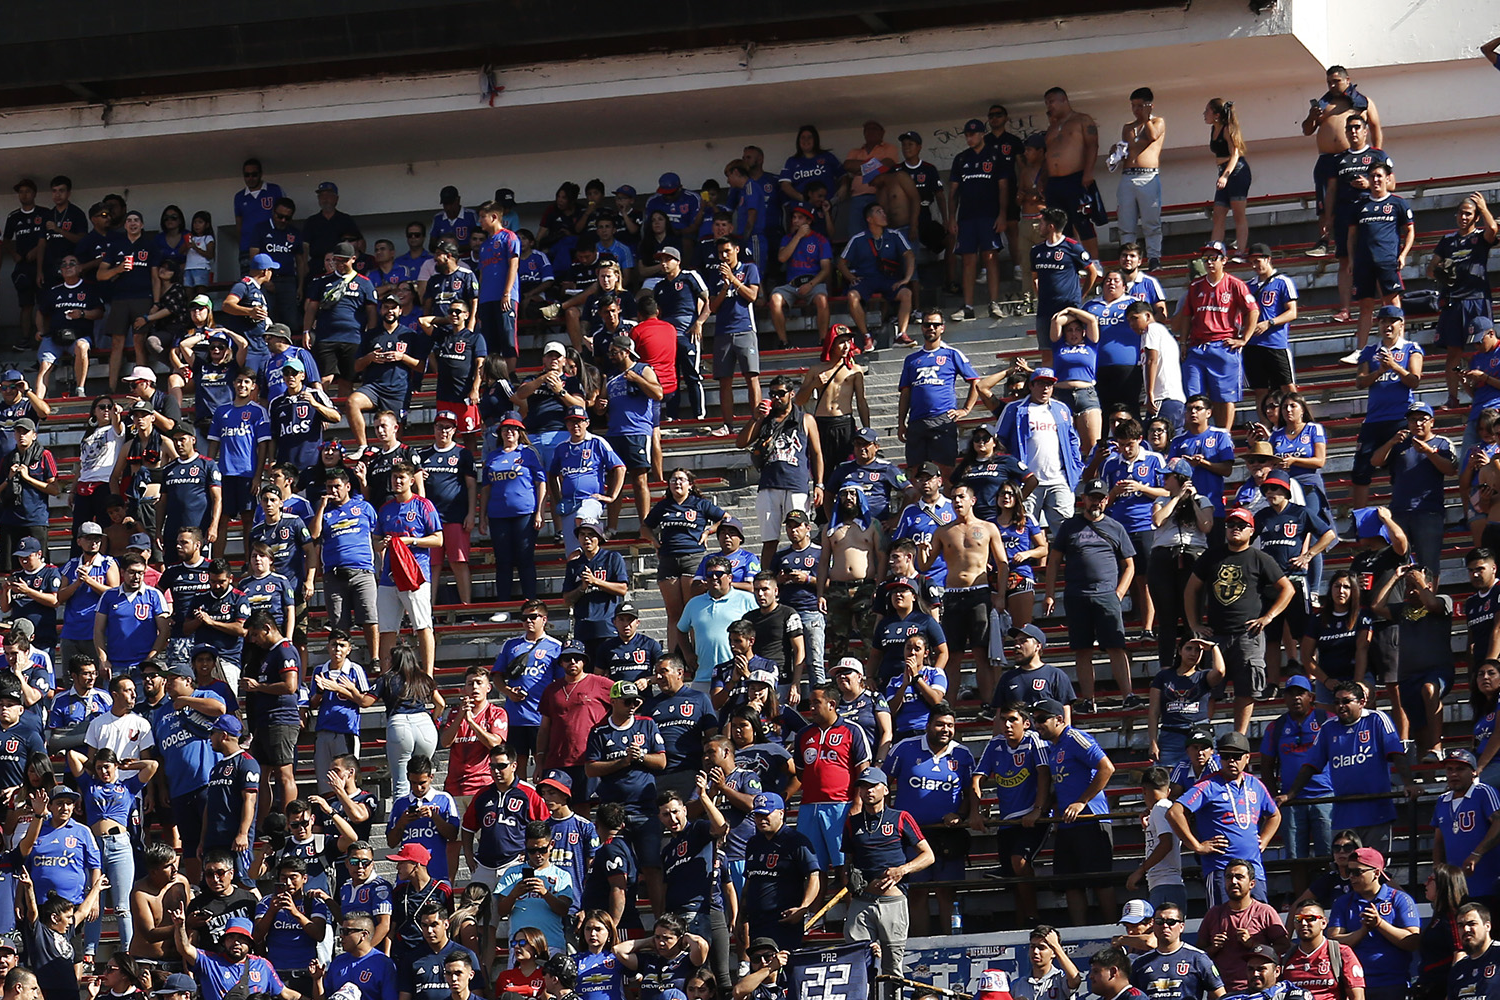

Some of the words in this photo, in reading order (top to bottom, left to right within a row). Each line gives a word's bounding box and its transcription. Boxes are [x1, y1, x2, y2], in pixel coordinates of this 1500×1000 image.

[793, 166, 826, 180] Claro
[280, 420, 310, 437] AdeS
[466, 417, 474, 429] 3
[488, 467, 522, 481] Claro
[819, 749, 838, 761] LG
[1332, 745, 1373, 769] Claro
[908, 775, 959, 793] Claro
[498, 813, 517, 827] LG
[403, 822, 439, 843] Claro
[34, 851, 75, 869] Claro
[581, 984, 613, 992] CHEVROLET
[1293, 978, 1335, 987] TROBRAS
